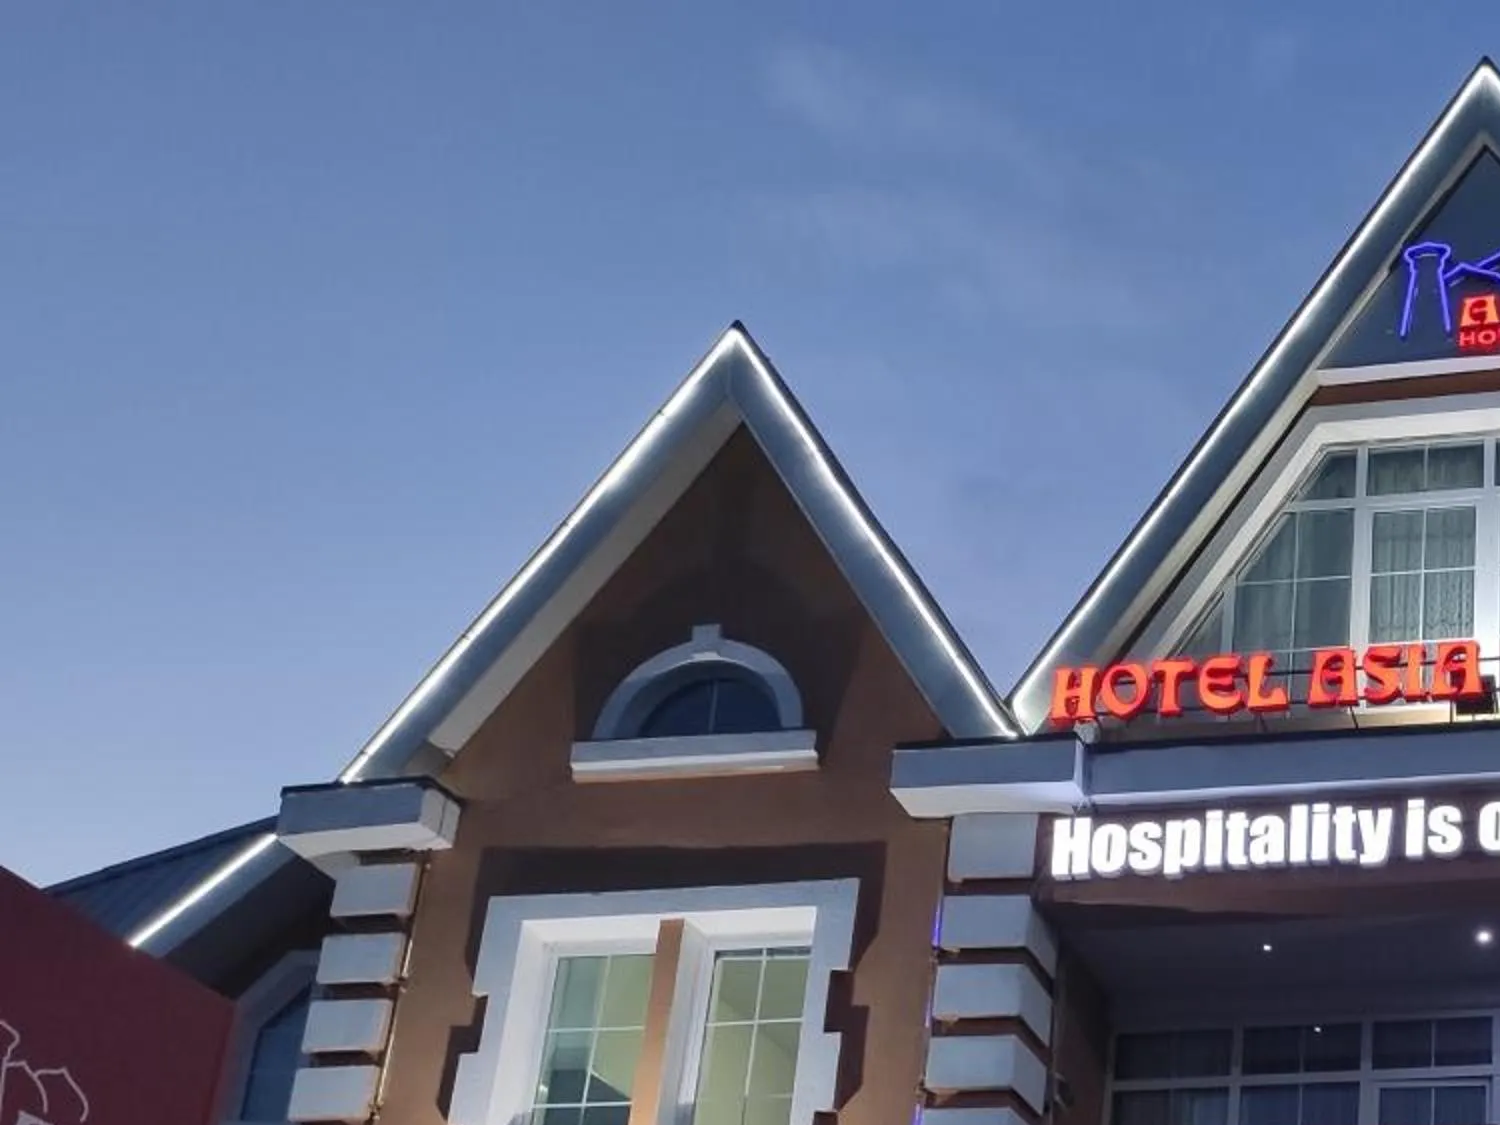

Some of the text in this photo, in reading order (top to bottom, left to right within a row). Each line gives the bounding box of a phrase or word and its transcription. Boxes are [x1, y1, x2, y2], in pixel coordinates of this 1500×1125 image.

[1049, 654, 1289, 722] HOTEL
[1309, 639, 1483, 705] ASIA
[1051, 803, 1392, 880] Hospitality
[1405, 799, 1463, 857] is
